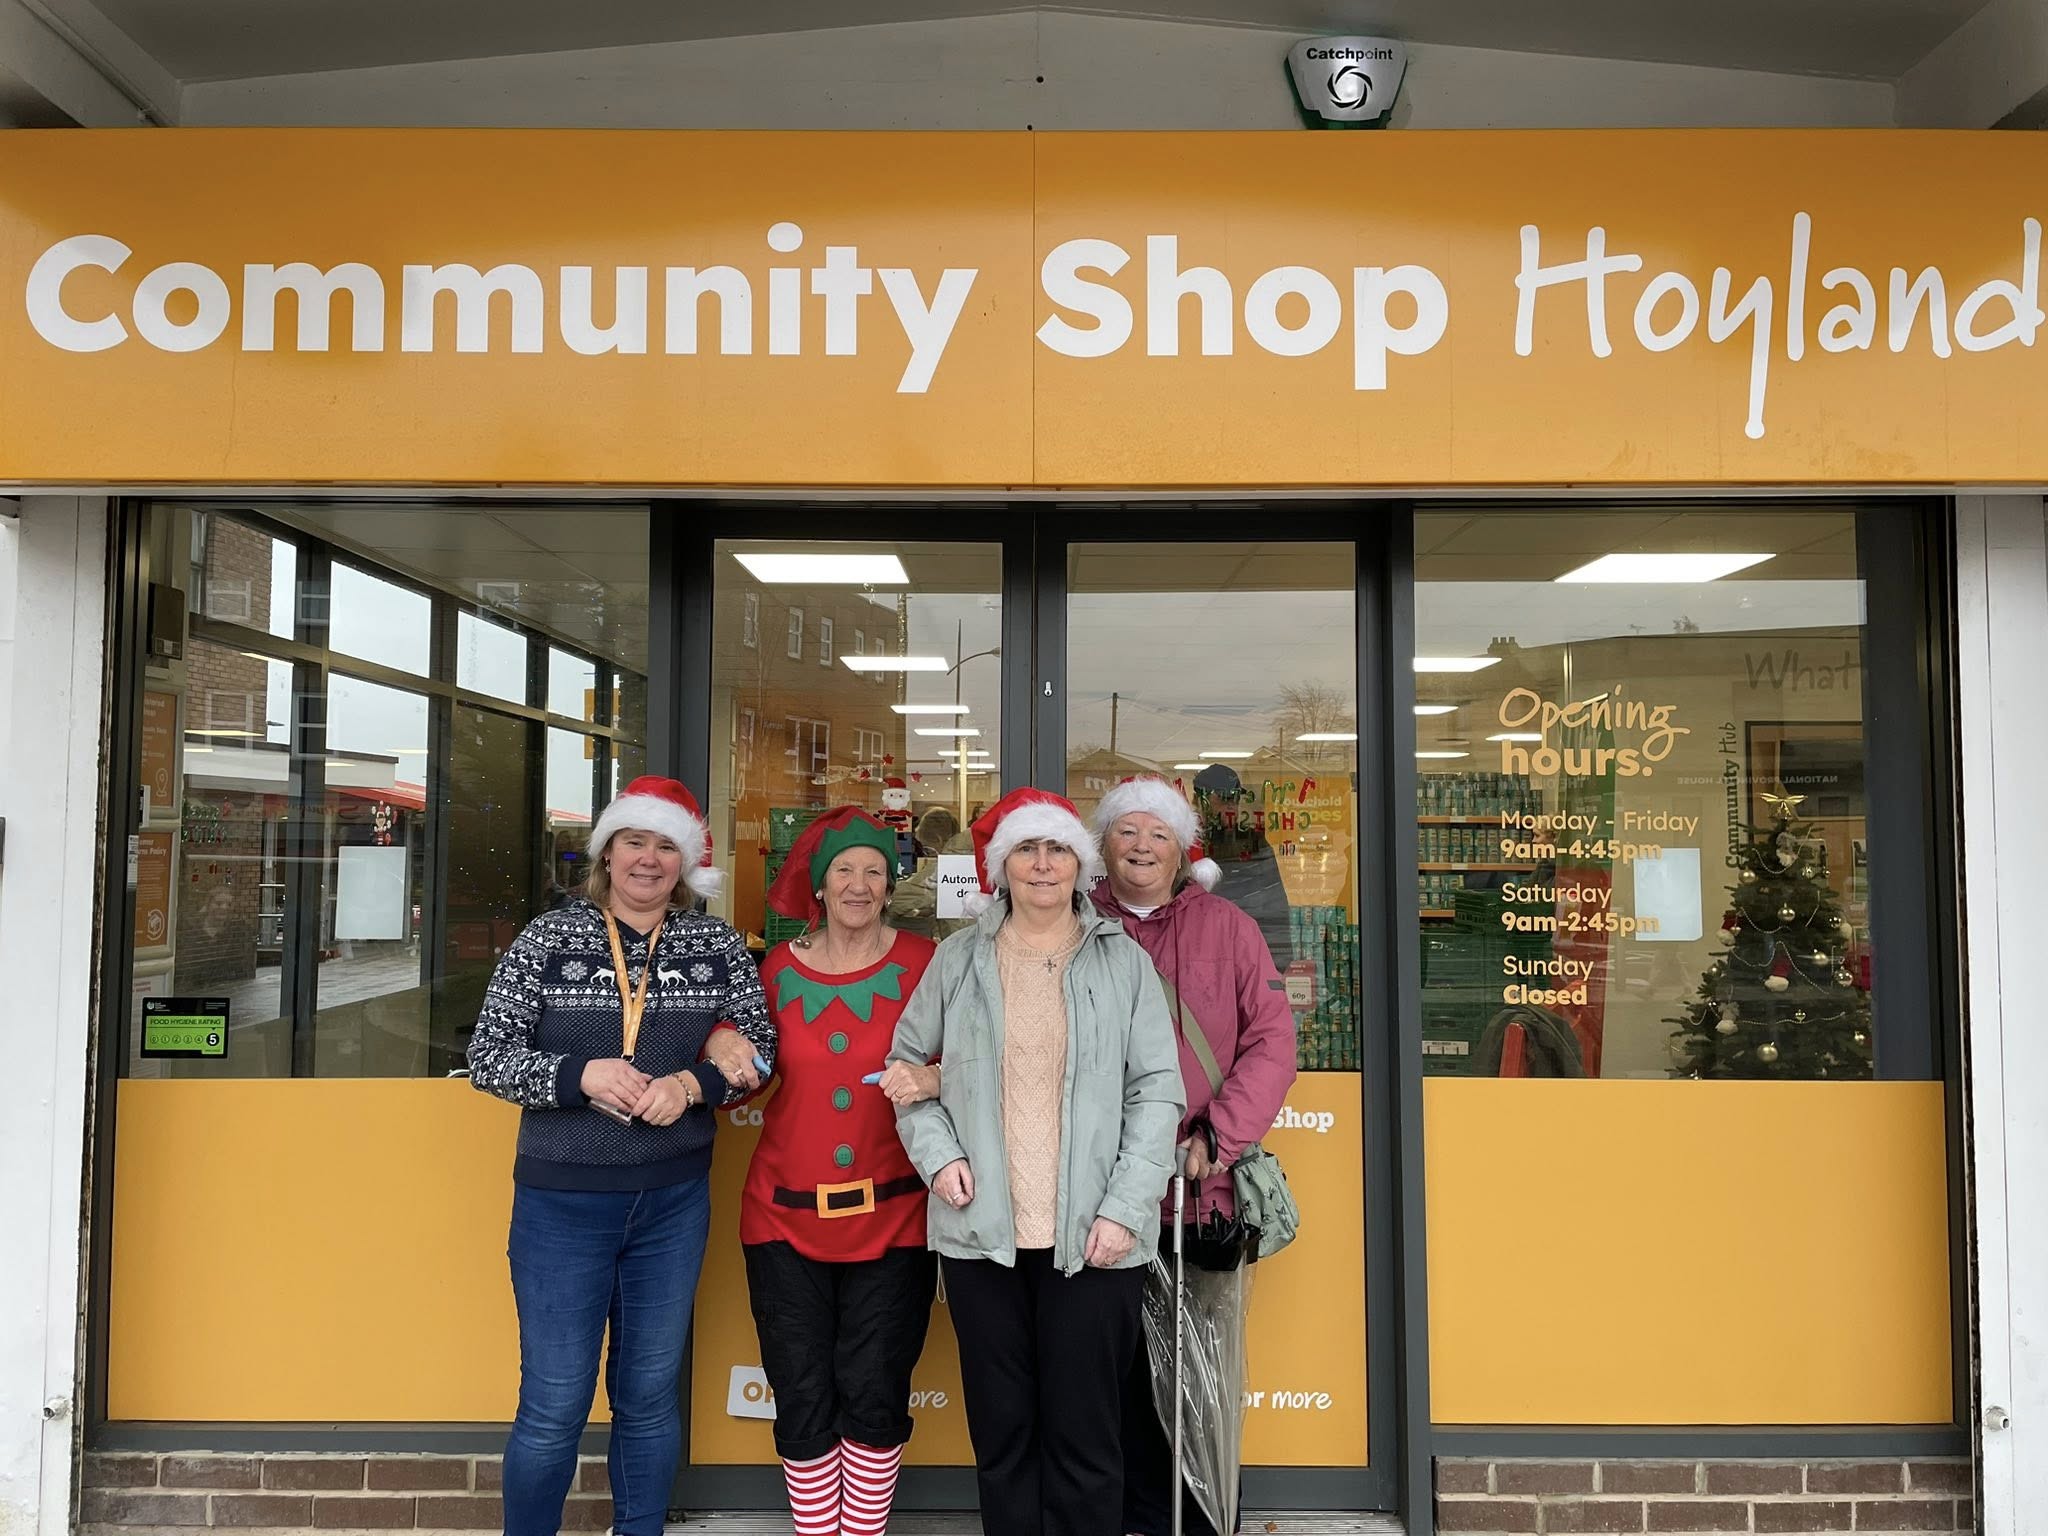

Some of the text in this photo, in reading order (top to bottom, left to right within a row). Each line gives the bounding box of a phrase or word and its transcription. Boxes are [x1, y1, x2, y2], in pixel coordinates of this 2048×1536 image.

[1306, 47, 1393, 62] Catchpoint
[25, 211, 2047, 440] Community Shop Hoyland
[1499, 684, 1691, 762] Opening
[1718, 720, 1737, 755] Hub
[1501, 738, 1653, 777] hours.
[1501, 810, 1598, 836] Monday
[1623, 810, 1699, 837] Friday
[1500, 839, 1663, 864] 9am-4:45pm
[941, 875, 977, 884] Autom
[1501, 882, 1612, 908] Saturday
[1501, 911, 1660, 937] 9am-2:45pm
[1503, 955, 1594, 981] Sunday
[1291, 992, 1306, 1001] 60p
[1503, 984, 1588, 1006] Closed
[209, 1034, 217, 1045] 5
[908, 1390, 948, 1408] ore
[1271, 1390, 1333, 1410] more
